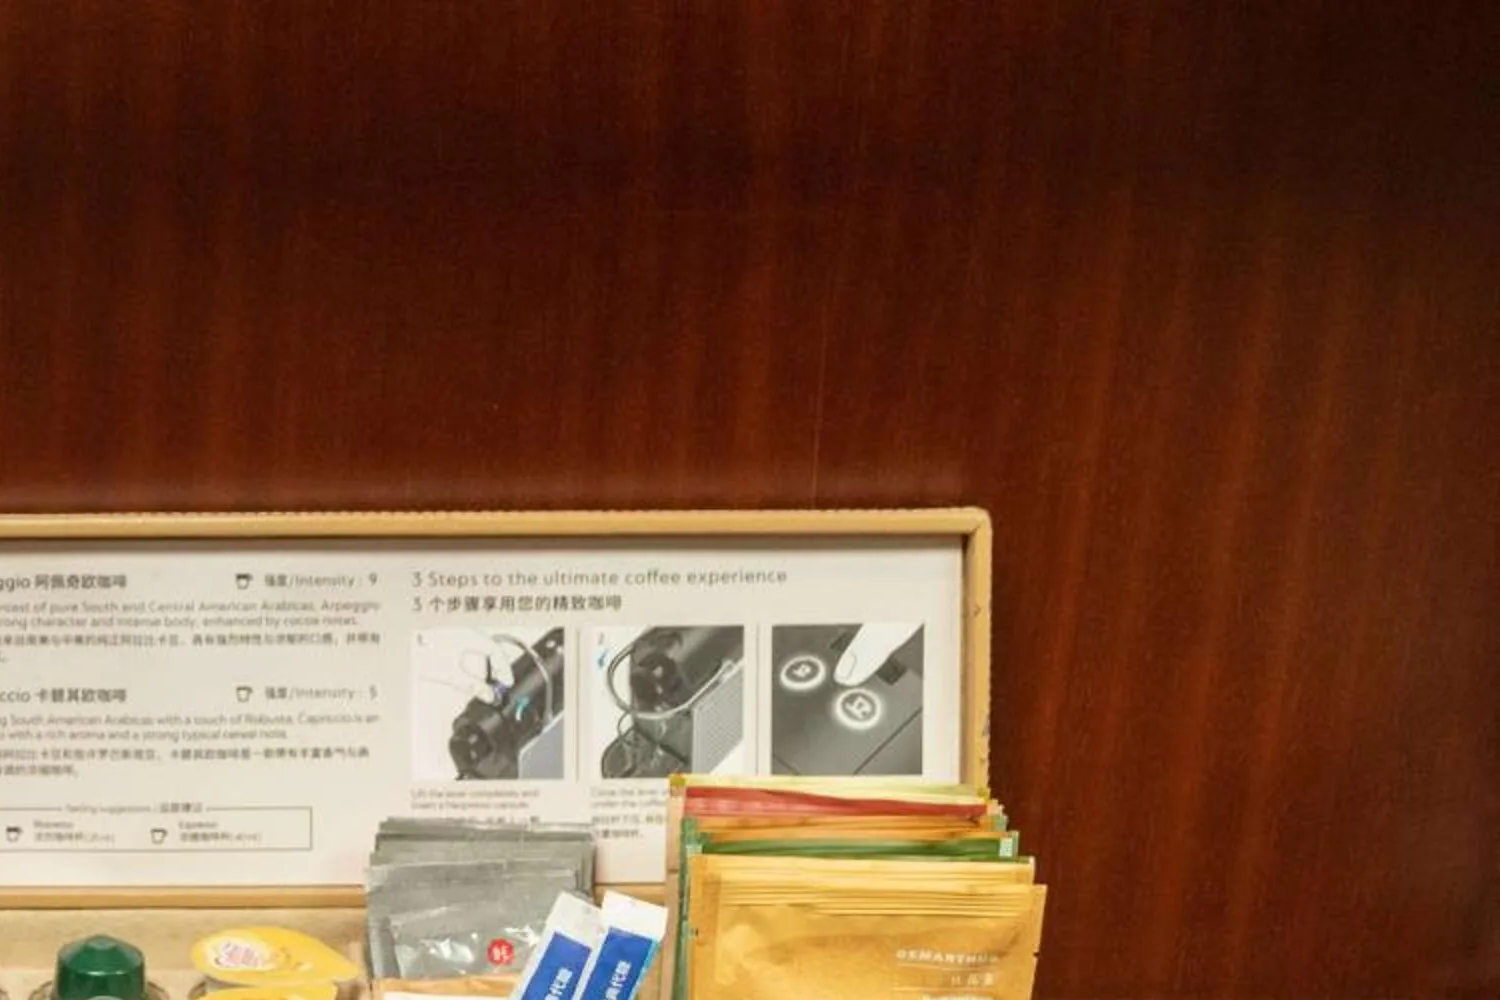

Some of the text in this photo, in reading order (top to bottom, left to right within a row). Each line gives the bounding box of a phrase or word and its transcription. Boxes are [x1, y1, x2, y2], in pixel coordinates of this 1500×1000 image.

[428, 571, 478, 588] Steps
[484, 571, 502, 588] to
[508, 571, 537, 588] the
[543, 571, 618, 588] ultimate
[625, 571, 680, 588] coffee
[687, 571, 788, 588] experience
